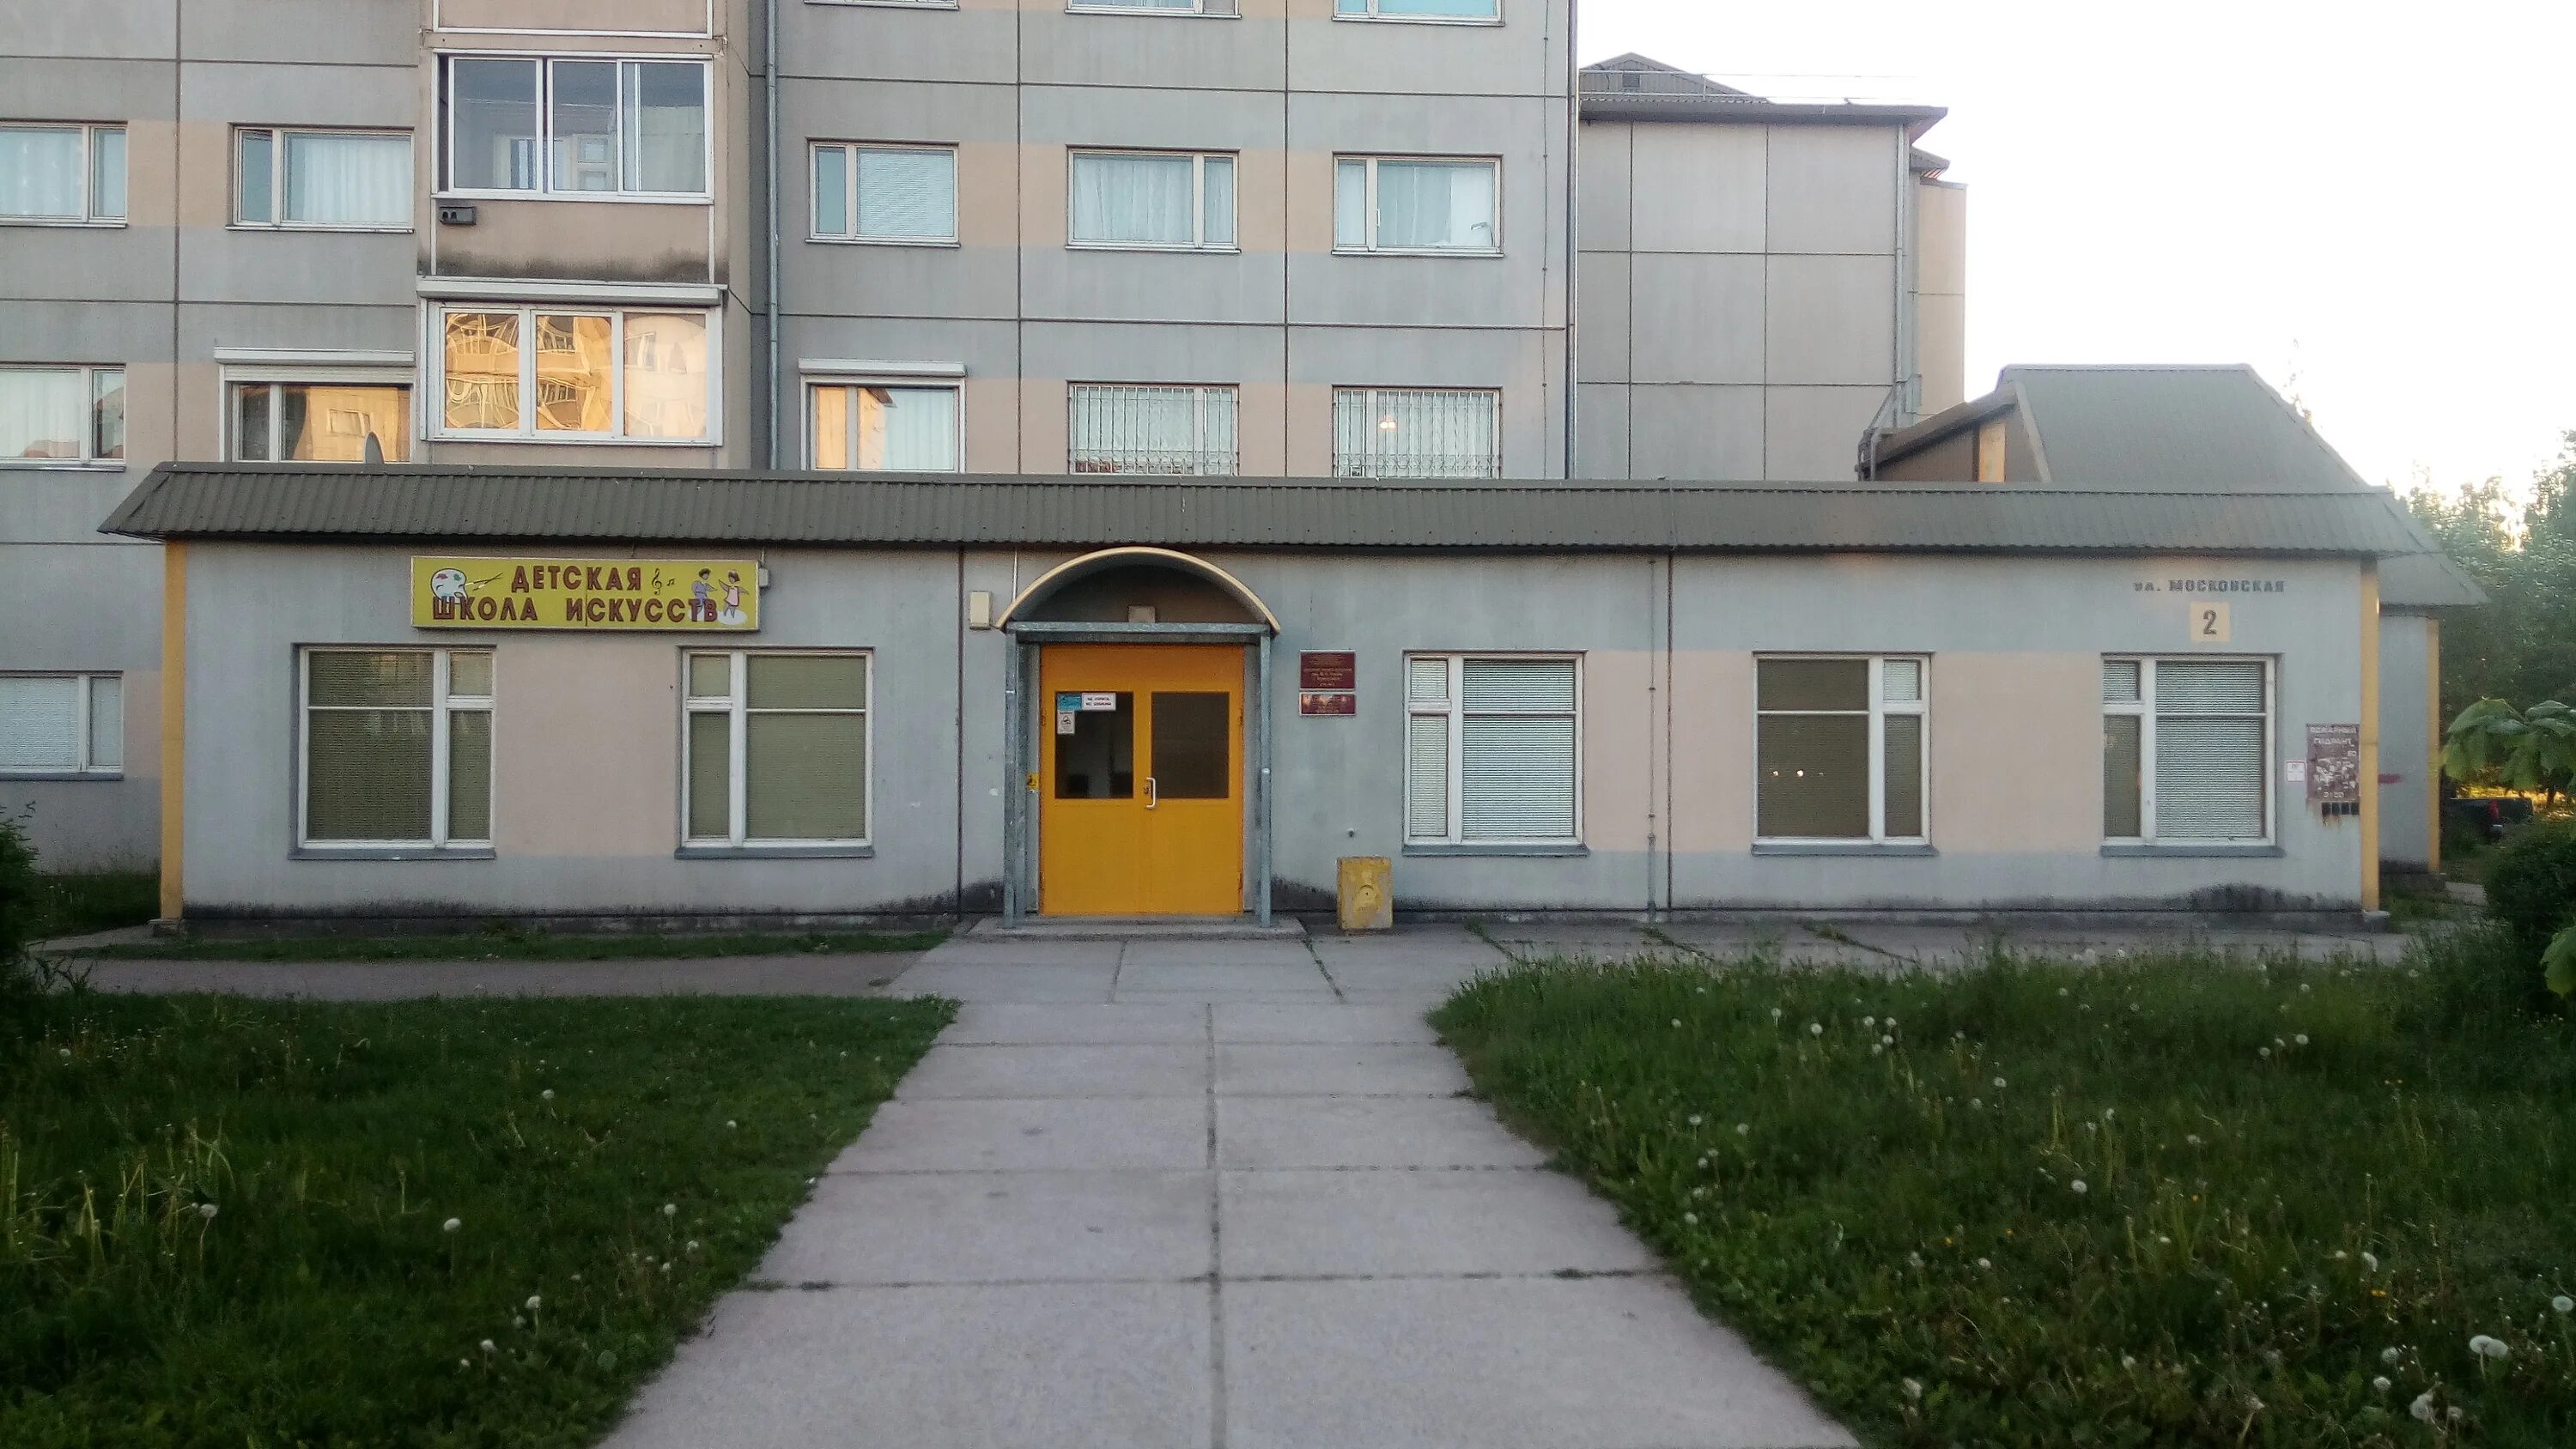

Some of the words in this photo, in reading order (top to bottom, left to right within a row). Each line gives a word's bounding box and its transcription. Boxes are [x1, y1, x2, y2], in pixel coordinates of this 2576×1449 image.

[511, 565, 641, 593] ДЕТСКАЯ
[2168, 579, 2285, 593] МОСКОВСКАЯ
[433, 596, 538, 621] ШКОЛА
[566, 597, 719, 622] ИСКУССТВ
[2202, 609, 2218, 635] 2
